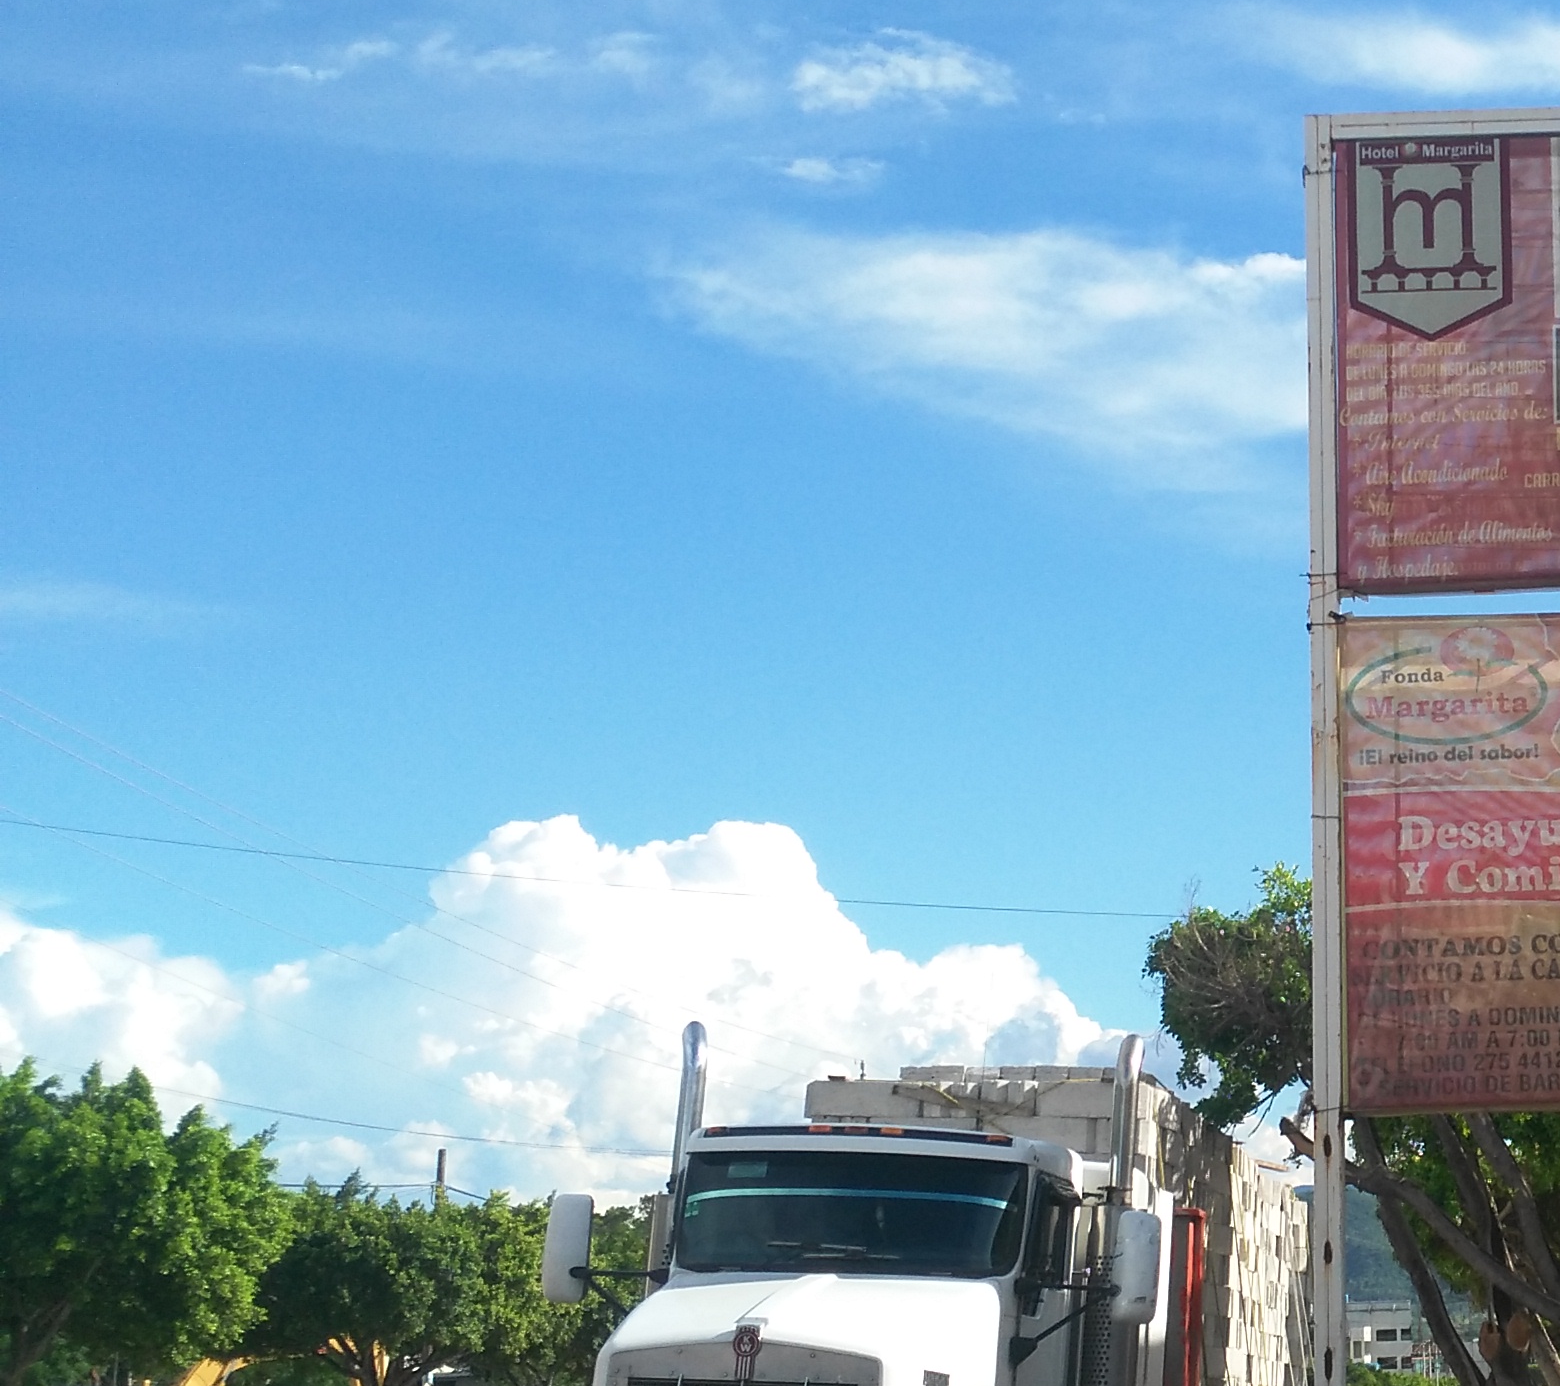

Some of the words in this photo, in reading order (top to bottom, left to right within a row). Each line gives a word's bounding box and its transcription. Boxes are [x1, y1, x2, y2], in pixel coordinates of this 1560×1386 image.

[1361, 145, 1399, 159] Hotel
[1422, 142, 1493, 158] Margarita
[1398, 342, 1414, 358] DE
[1346, 365, 1360, 381] DE
[1363, 363, 1398, 381] LUNES
[1400, 363, 1409, 379] A
[1411, 362, 1463, 378] DOMINGO
[1466, 361, 1487, 376] LAS
[1490, 360, 1505, 376] 24
[1508, 359, 1547, 375] HORAS
[1346, 385, 1364, 402] DEL
[1395, 383, 1415, 399] LOS
[1472, 382, 1493, 397] DEL
[1339, 407, 1414, 427] Contamos
[1420, 410, 1448, 424] con
[1451, 401, 1519, 423] Servicios
[1523, 399, 1548, 421] de:
[1364, 432, 1440, 452] Internet
[1365, 461, 1397, 485] Aire
[1401, 458, 1508, 485] Acondicionado
[1367, 492, 1395, 524] Sky
[1367, 524, 1454, 548] Facturación
[1457, 521, 1476, 544] de
[1479, 519, 1553, 543] Alimentos
[1356, 566, 1367, 585] y
[1381, 667, 1444, 684] Fonda
[1365, 692, 1529, 723] Margarita
[1389, 748, 1439, 765] reino
[1444, 745, 1474, 762] del
[1479, 743, 1540, 761] sabor!
[1398, 861, 1430, 895] Y
[1363, 935, 1522, 960] CONTAMOS
[1470, 961, 1484, 983] A
[1494, 961, 1524, 982] LA
[1467, 1009, 1481, 1027] A
[1447, 1030, 1478, 1050] AM
[1487, 1031, 1500, 1048] A
[1507, 1029, 1550, 1048] 7:00
[1473, 1053, 1510, 1072] 275
[1378, 1074, 1477, 1098] SERVICIO
[1486, 1074, 1509, 1093] DE
[1519, 1073, 1560, 1092] BAR
